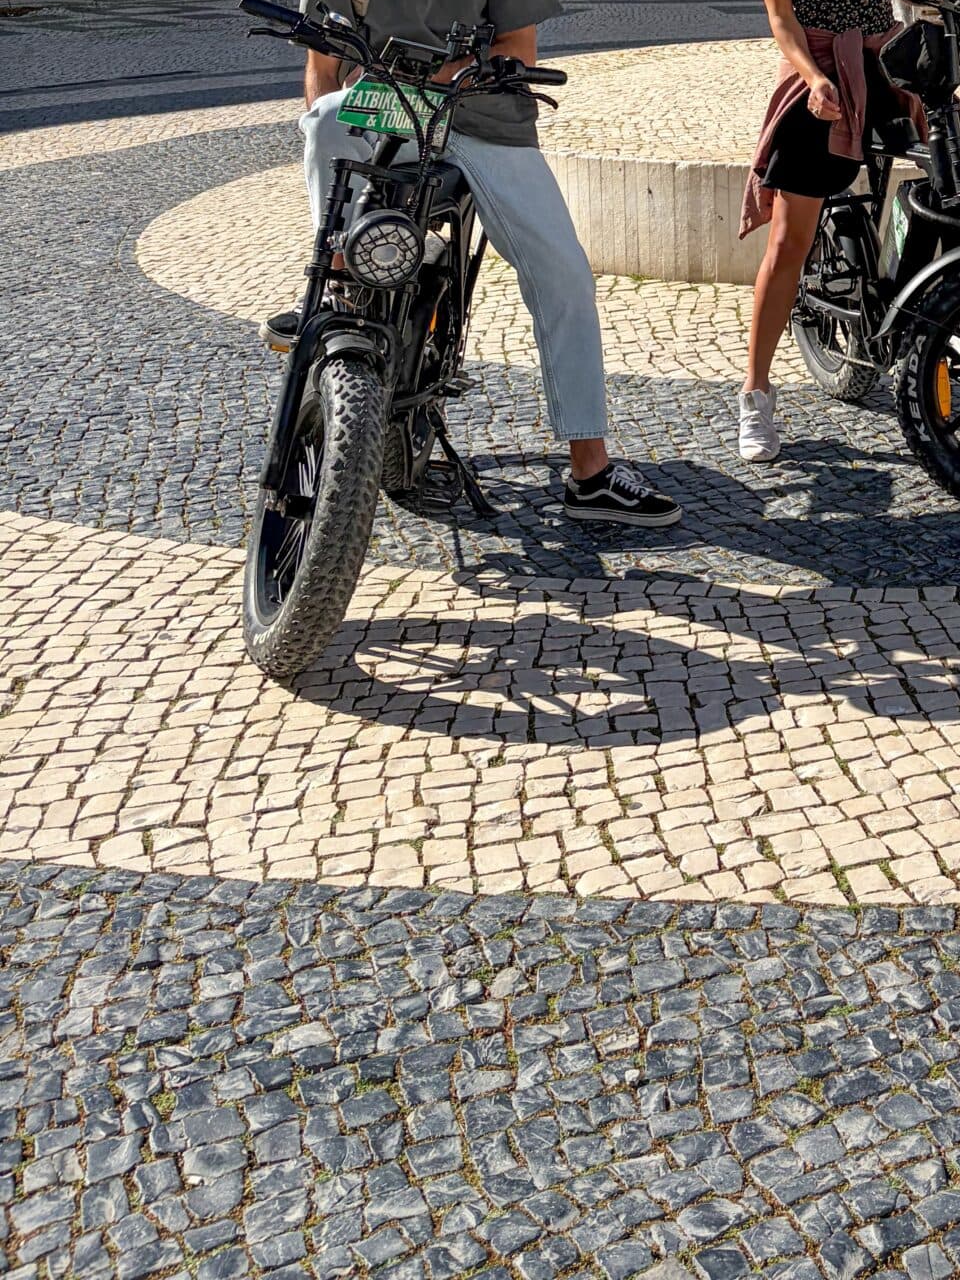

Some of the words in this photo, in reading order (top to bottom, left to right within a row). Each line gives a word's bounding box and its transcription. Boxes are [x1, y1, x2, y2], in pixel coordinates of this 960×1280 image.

[346, 89, 397, 110] FATBIKE
[366, 114, 376, 127] &
[907, 335, 932, 443] KENDA
